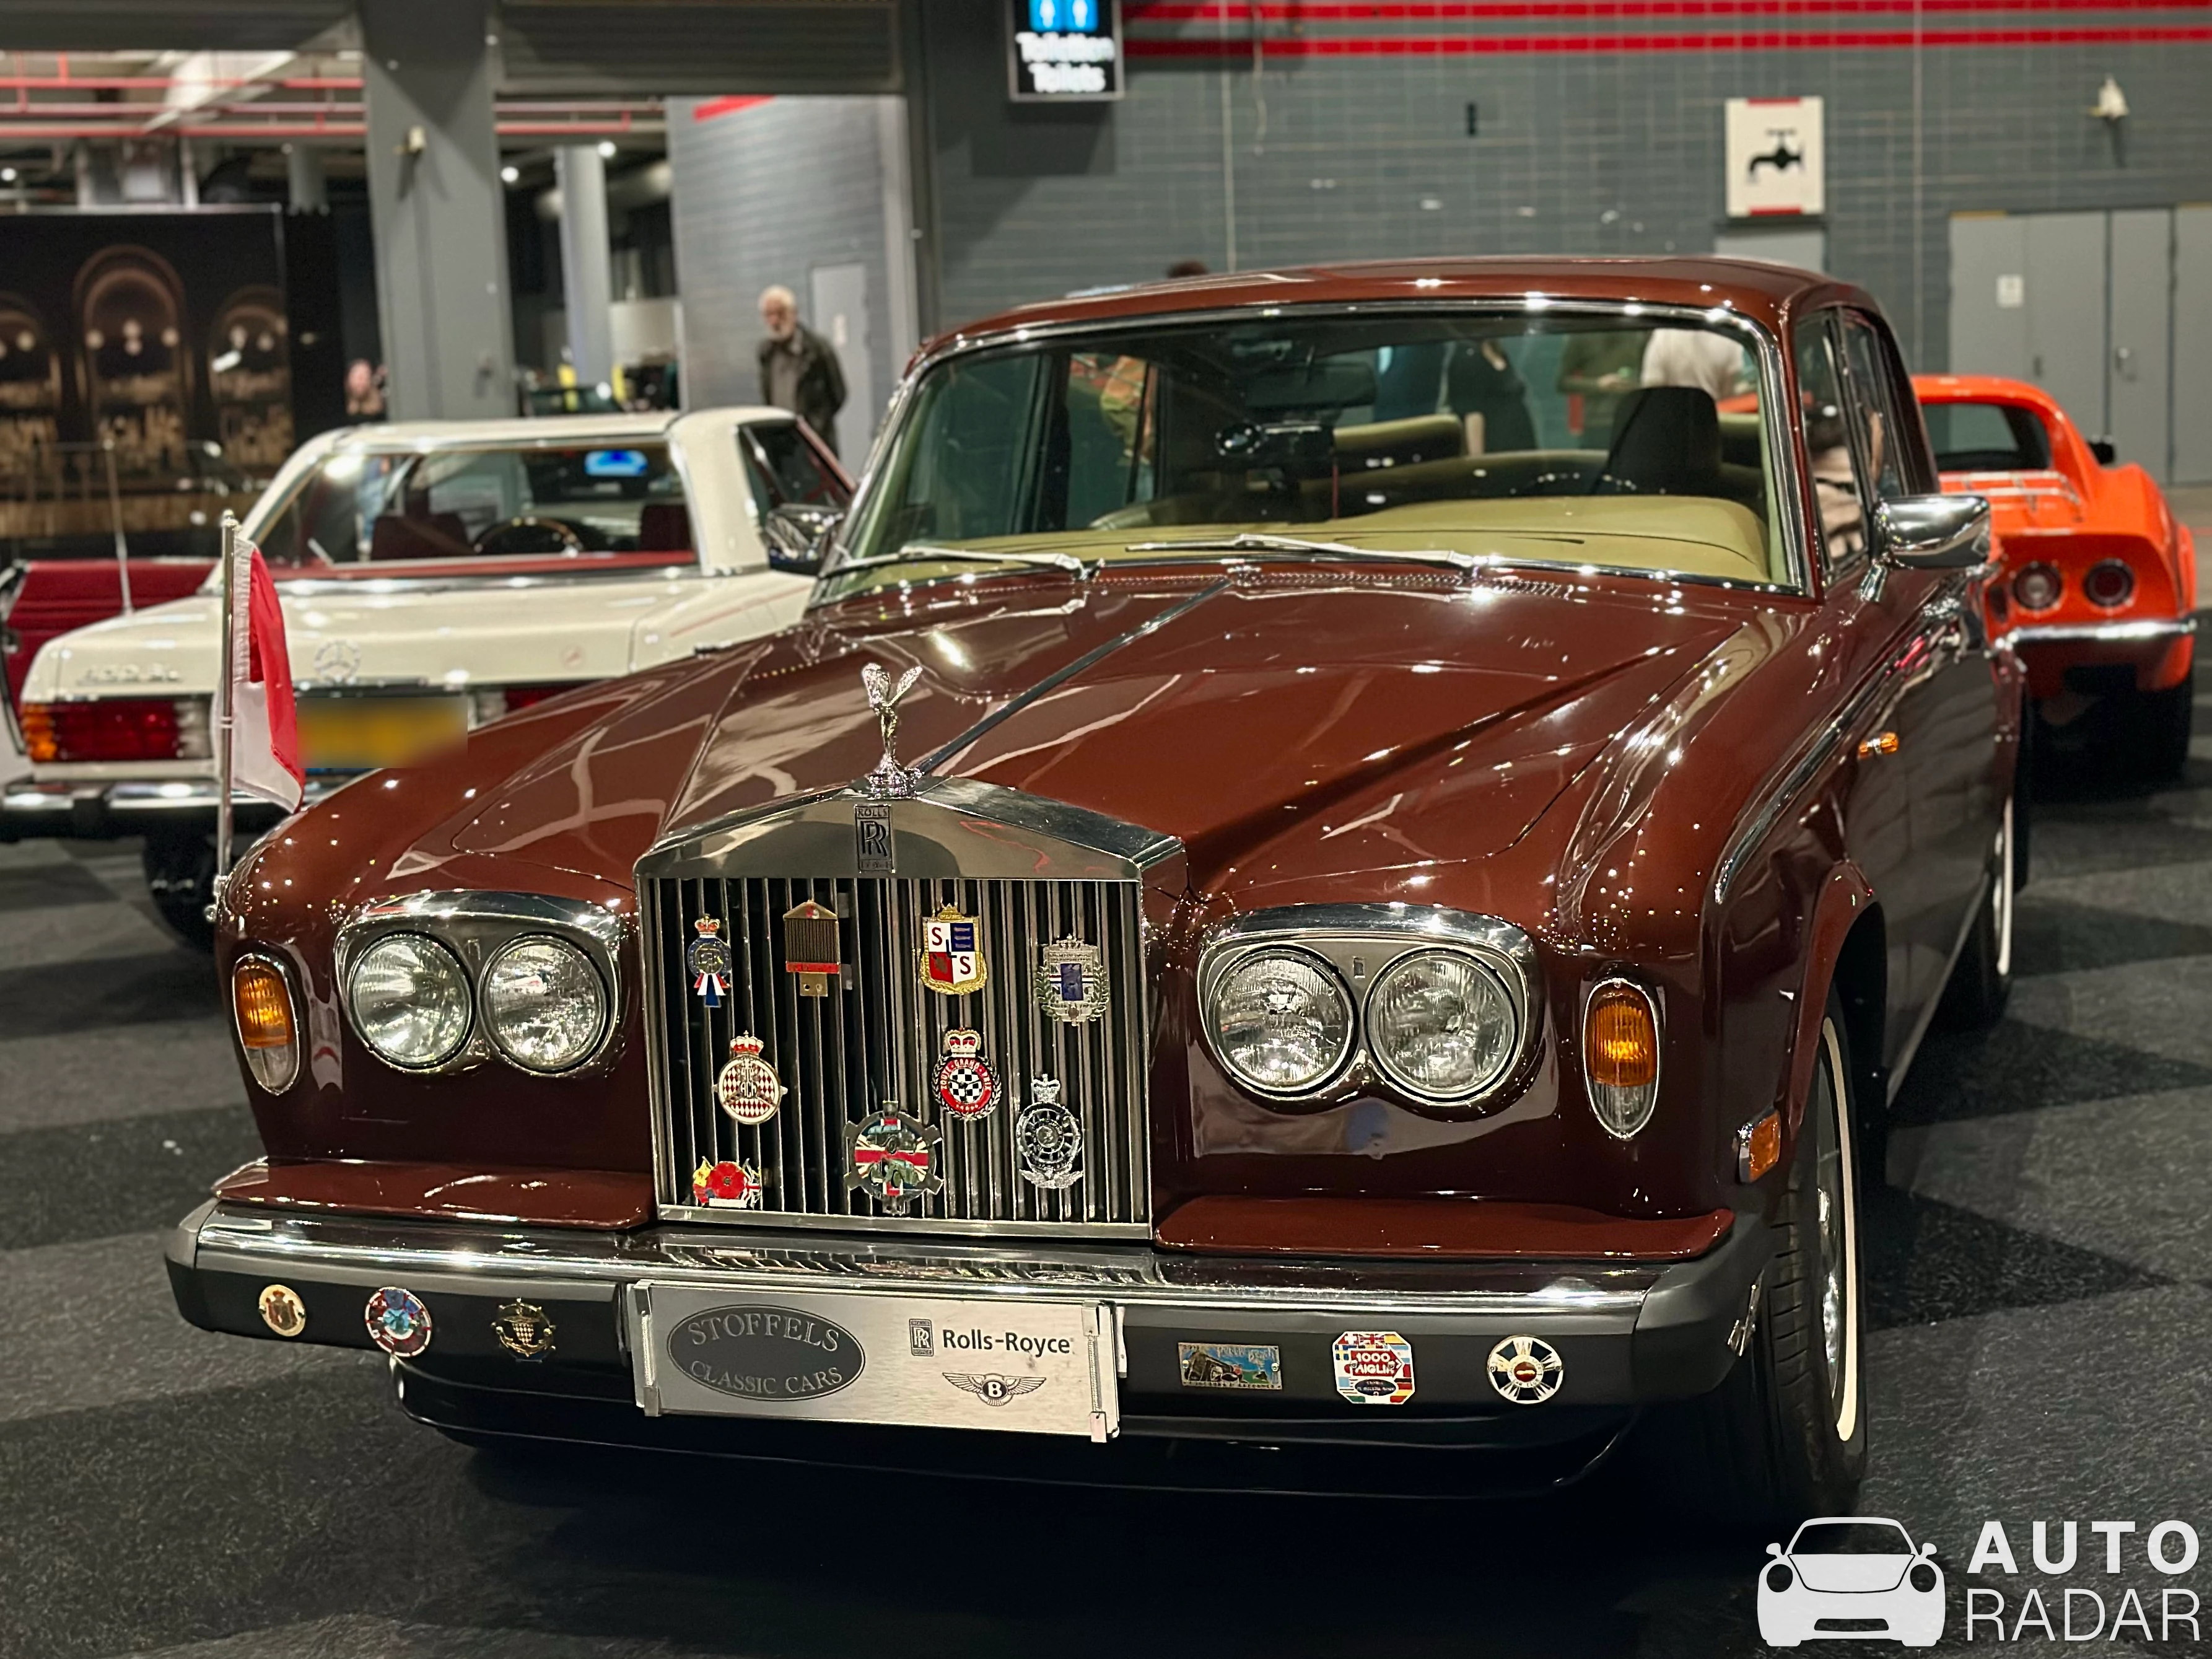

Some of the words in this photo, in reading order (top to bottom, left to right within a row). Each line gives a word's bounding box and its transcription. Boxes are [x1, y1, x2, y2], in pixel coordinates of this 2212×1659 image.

[857, 808, 888, 816] ROLLS
[932, 927, 942, 946] S
[960, 956, 971, 974] S
[688, 1313, 839, 1351] STOFFELS
[942, 1329, 1070, 1357] Rolls-Royce
[1356, 1352, 1391, 1362] 1000
[690, 1361, 777, 1394] CLASSIC
[785, 1367, 842, 1393] CARS
[988, 1381, 1003, 1398] B
